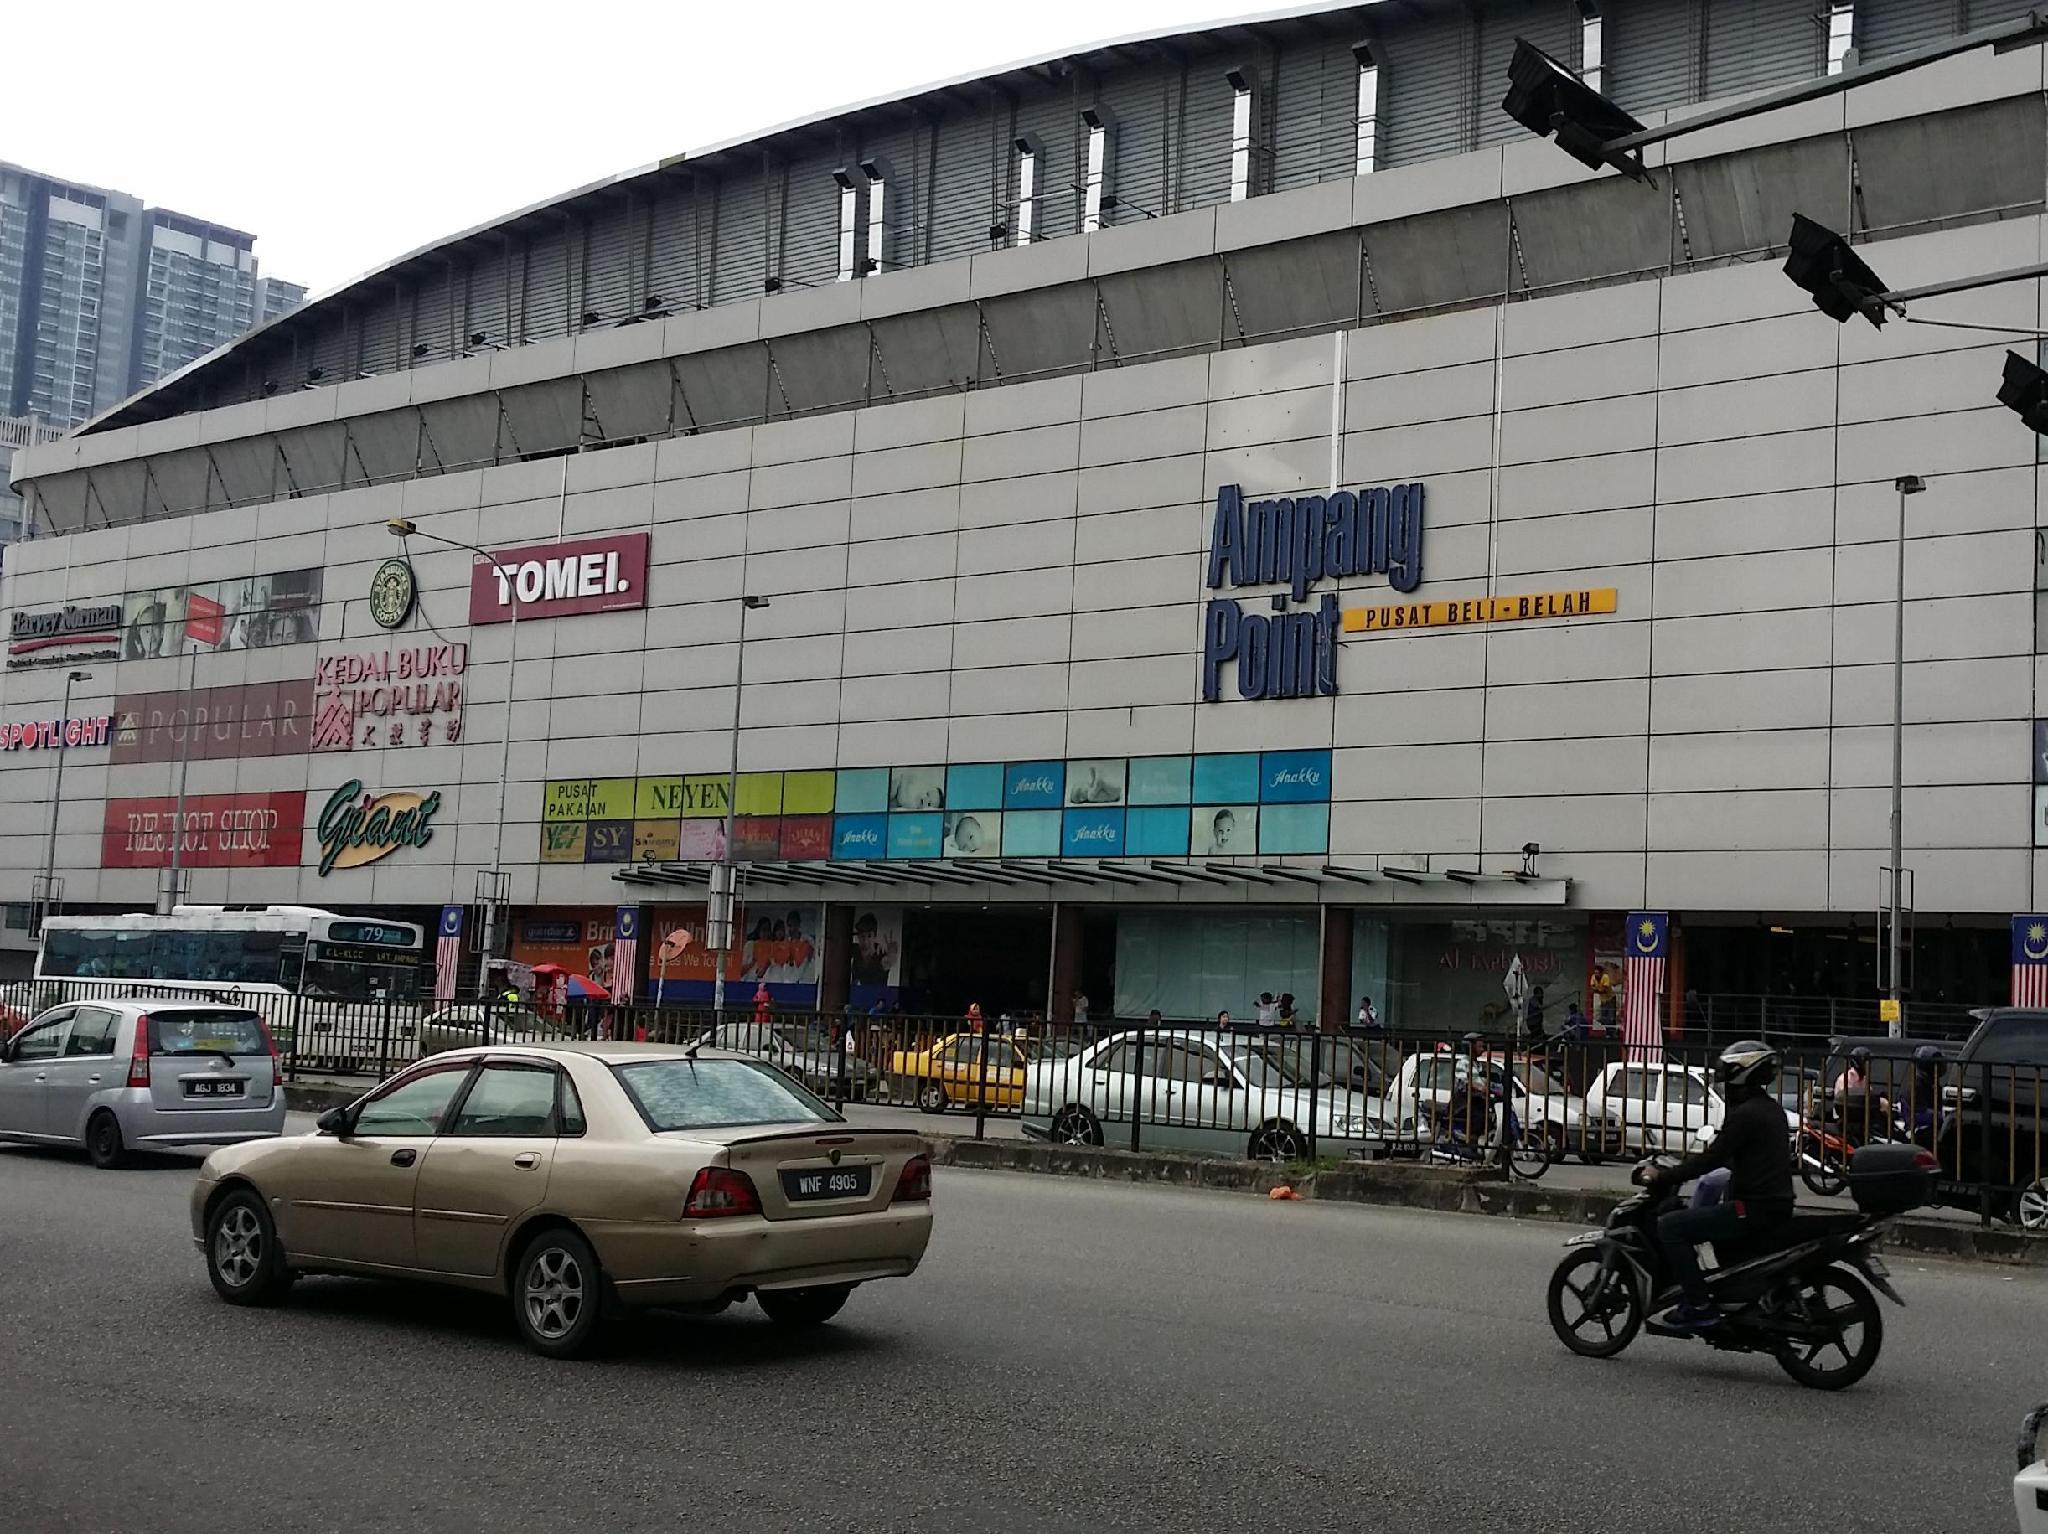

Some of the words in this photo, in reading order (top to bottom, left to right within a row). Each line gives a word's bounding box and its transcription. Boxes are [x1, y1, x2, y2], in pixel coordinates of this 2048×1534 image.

[1207, 483, 1424, 602] Ampang
[11, 611, 62, 637] Harvey
[60, 604, 121, 630] Norman
[1366, 605, 1431, 629] PUSAT
[1203, 593, 1341, 704] Point
[316, 651, 390, 686] KEDAI
[398, 643, 468, 680] BUKU
[354, 681, 461, 718] POPULAR
[0, 716, 110, 751] SPOTLGHT
[149, 700, 299, 745] POPULAR
[557, 784, 598, 799] PUSAT
[1011, 775, 1056, 796] Anakku
[1269, 767, 1322, 789] Anakku
[548, 802, 606, 816] PAKAIAN
[651, 782, 731, 810] NEYEN
[219, 808, 279, 851] SHOP
[317, 778, 441, 877] Giant
[592, 826, 626, 848] SY
[1071, 823, 1116, 843] Anakku
[364, 926, 384, 942] 79
[800, 1176, 822, 1194] WNF
[829, 1174, 857, 1192] 4905
